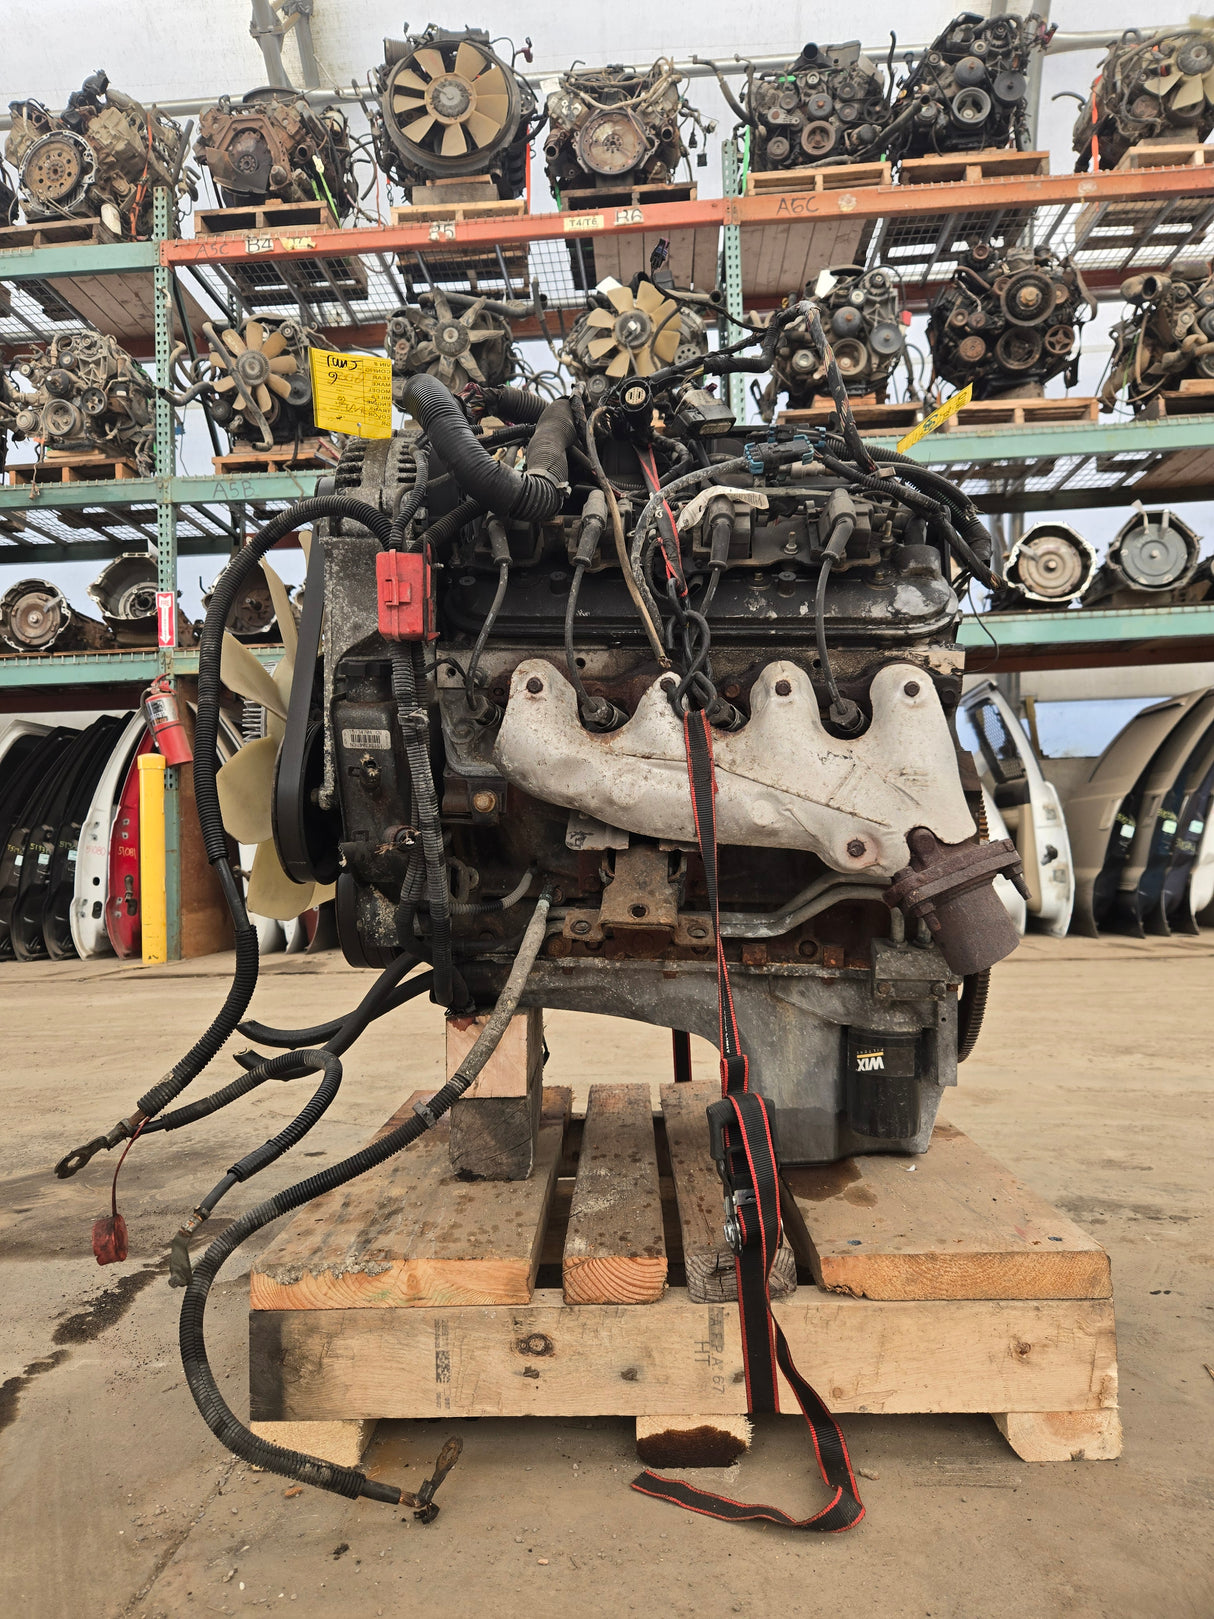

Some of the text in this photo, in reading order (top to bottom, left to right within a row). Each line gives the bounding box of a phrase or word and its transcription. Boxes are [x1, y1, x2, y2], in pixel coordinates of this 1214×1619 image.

[213, 480, 255, 500] A5B
[856, 1056, 885, 1072] WIX
[694, 1341, 710, 1367] HT
[712, 1375, 725, 1394] 67
